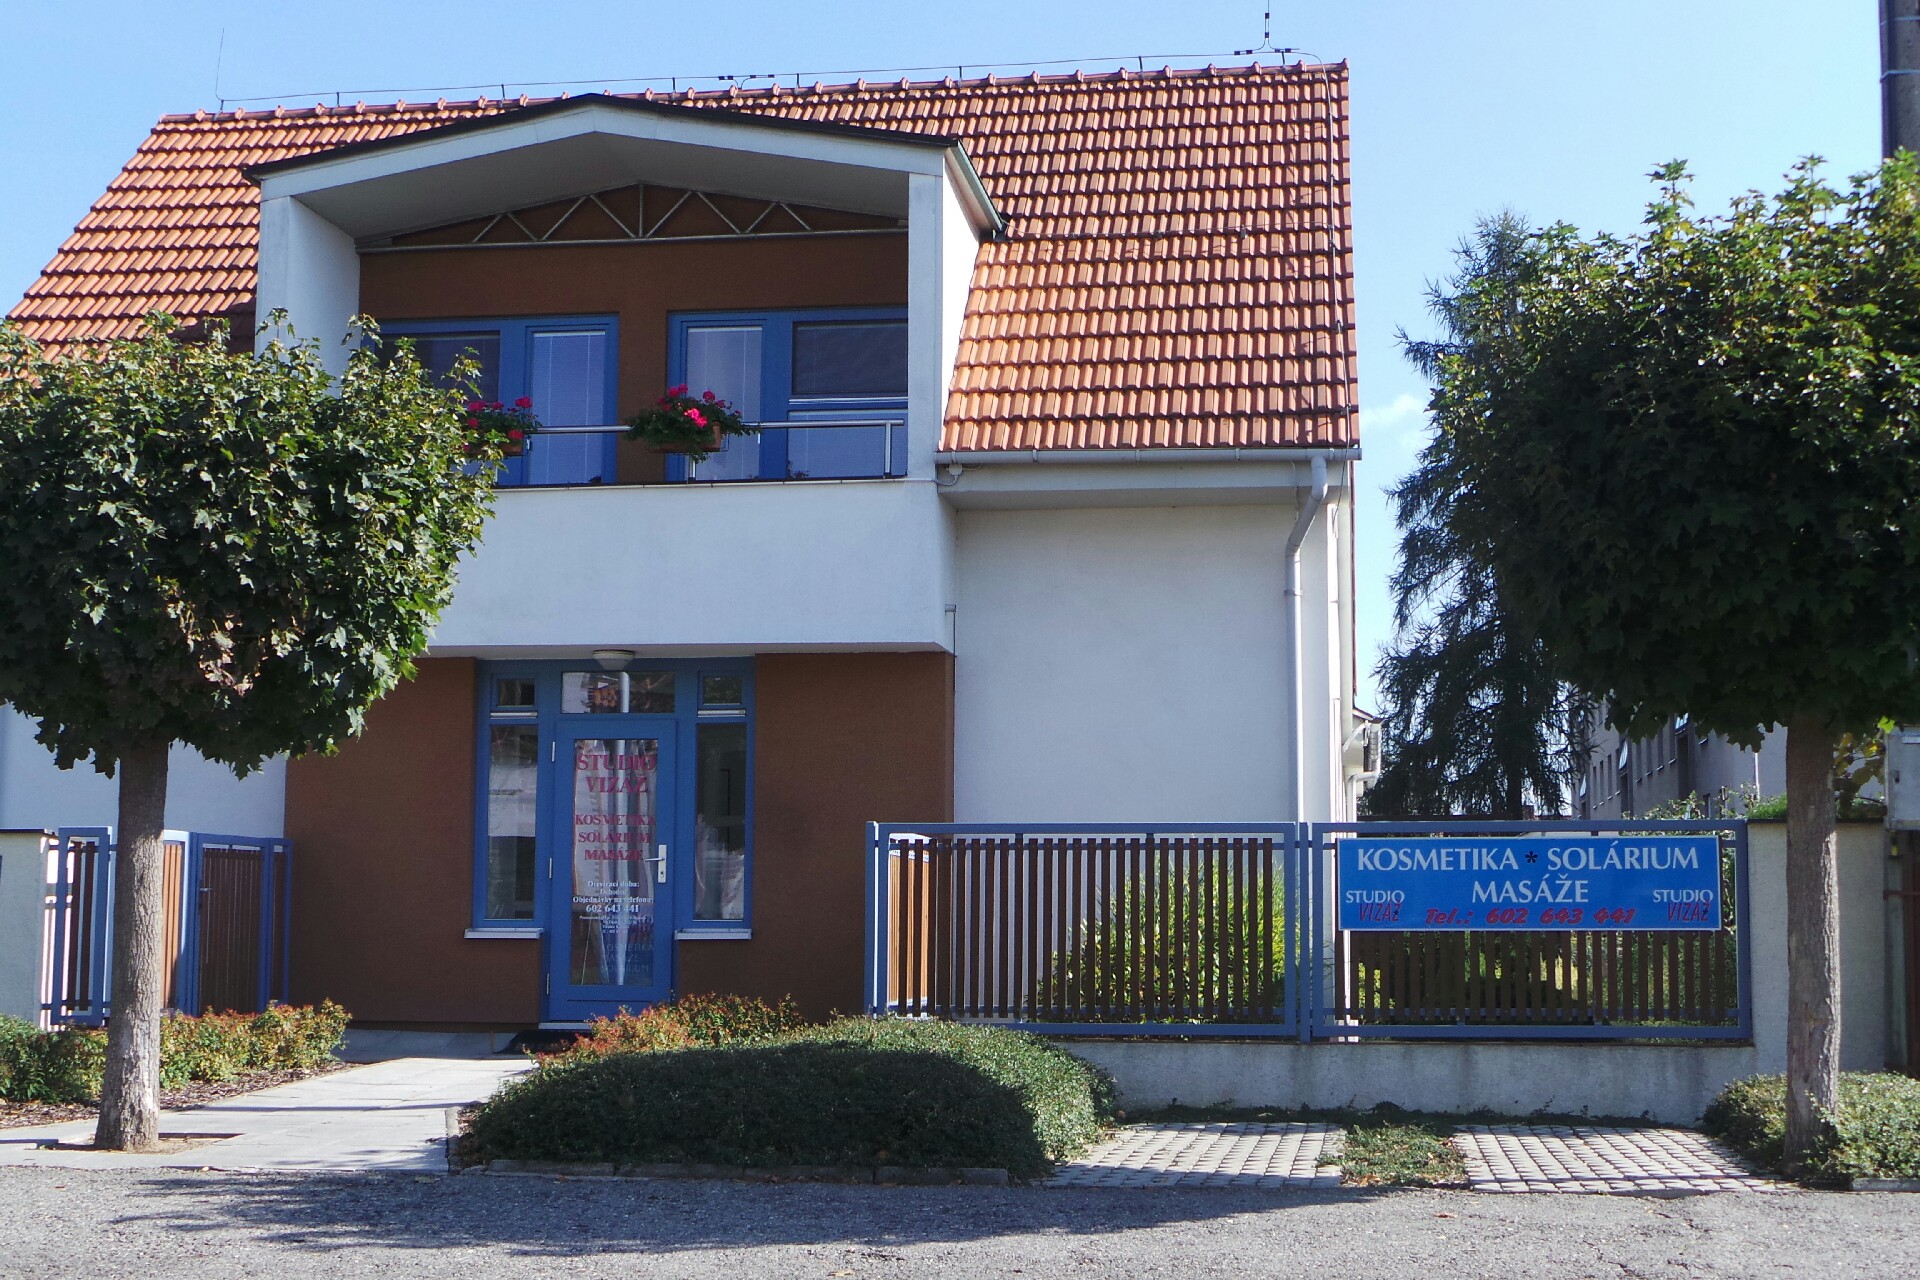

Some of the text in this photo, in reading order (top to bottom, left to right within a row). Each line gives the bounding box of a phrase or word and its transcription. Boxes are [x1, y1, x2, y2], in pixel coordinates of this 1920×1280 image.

[577, 754, 657, 771] STUDIO
[575, 814, 656, 825] KOSMETIKA
[1357, 841, 1699, 871] KOSMETIKA SOLÁRIUM
[1471, 873, 1589, 904] MASÁŽE
[1652, 889, 1714, 903] STUDIO
[1345, 890, 1405, 903] STUDIO
[585, 904, 640, 913] 602 643 441
[1425, 906, 1636, 925] Tel.: 602 643 441
